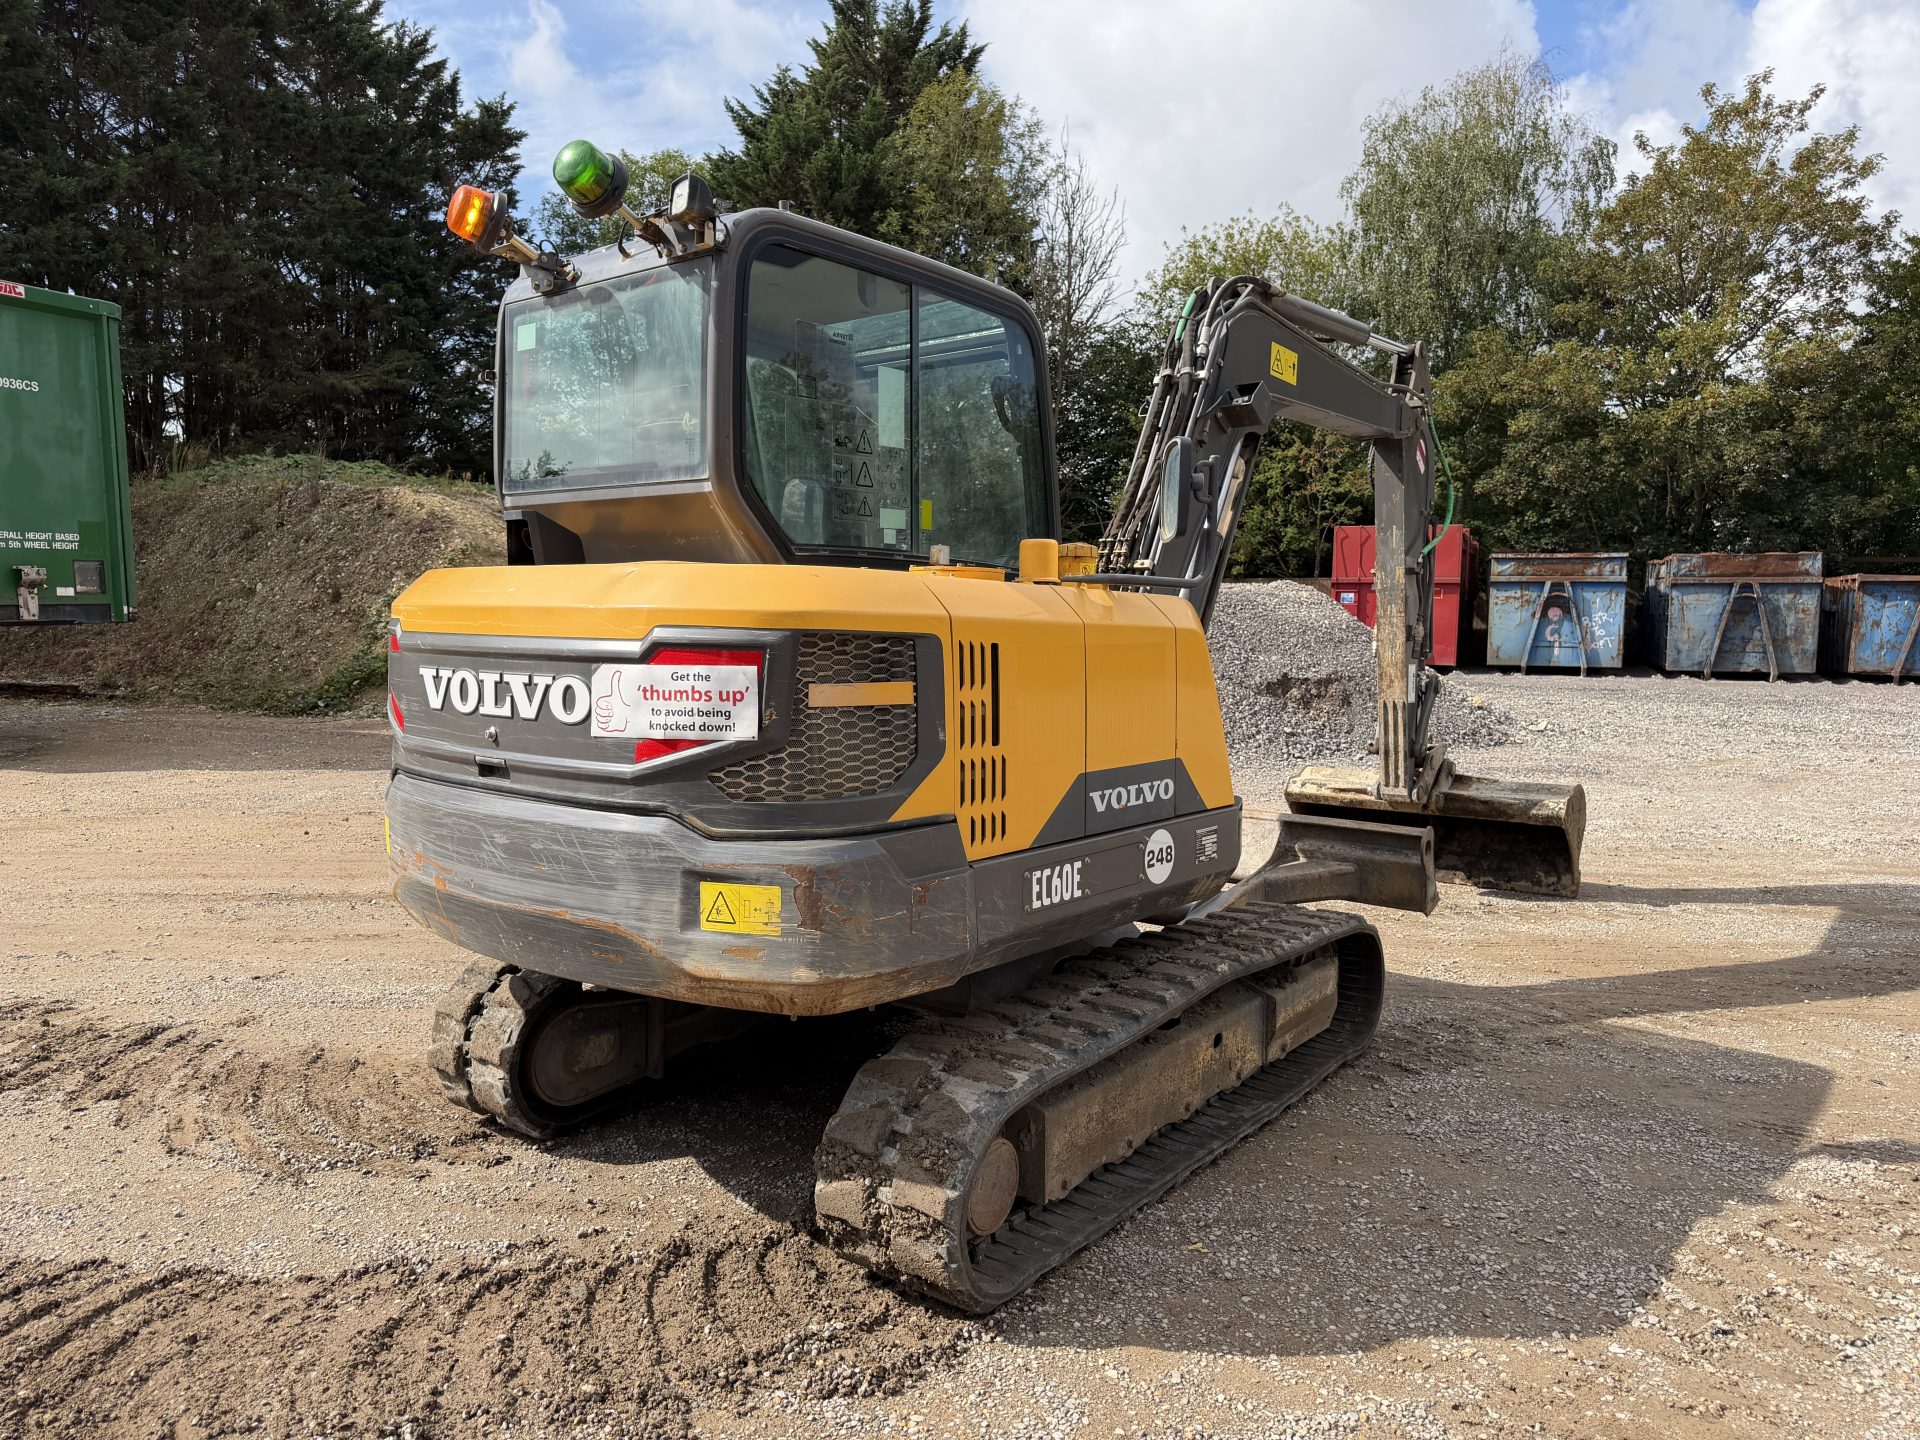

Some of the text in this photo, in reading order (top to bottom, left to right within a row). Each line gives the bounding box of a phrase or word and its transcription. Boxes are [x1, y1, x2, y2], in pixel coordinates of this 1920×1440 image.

[25, 531, 53, 540] HEIGHT
[55, 532, 80, 541] BASED
[23, 541, 51, 549] WHEEL
[52, 541, 79, 550] HEIGHT
[671, 671, 711, 682] Get the
[418, 665, 592, 726] VOLVO
[651, 707, 732, 720] to avoid being
[649, 720, 736, 732] knocked down!
[1089, 778, 1174, 813] VOLVO
[1146, 844, 1173, 869] 248
[1032, 860, 1082, 909] EC60E
